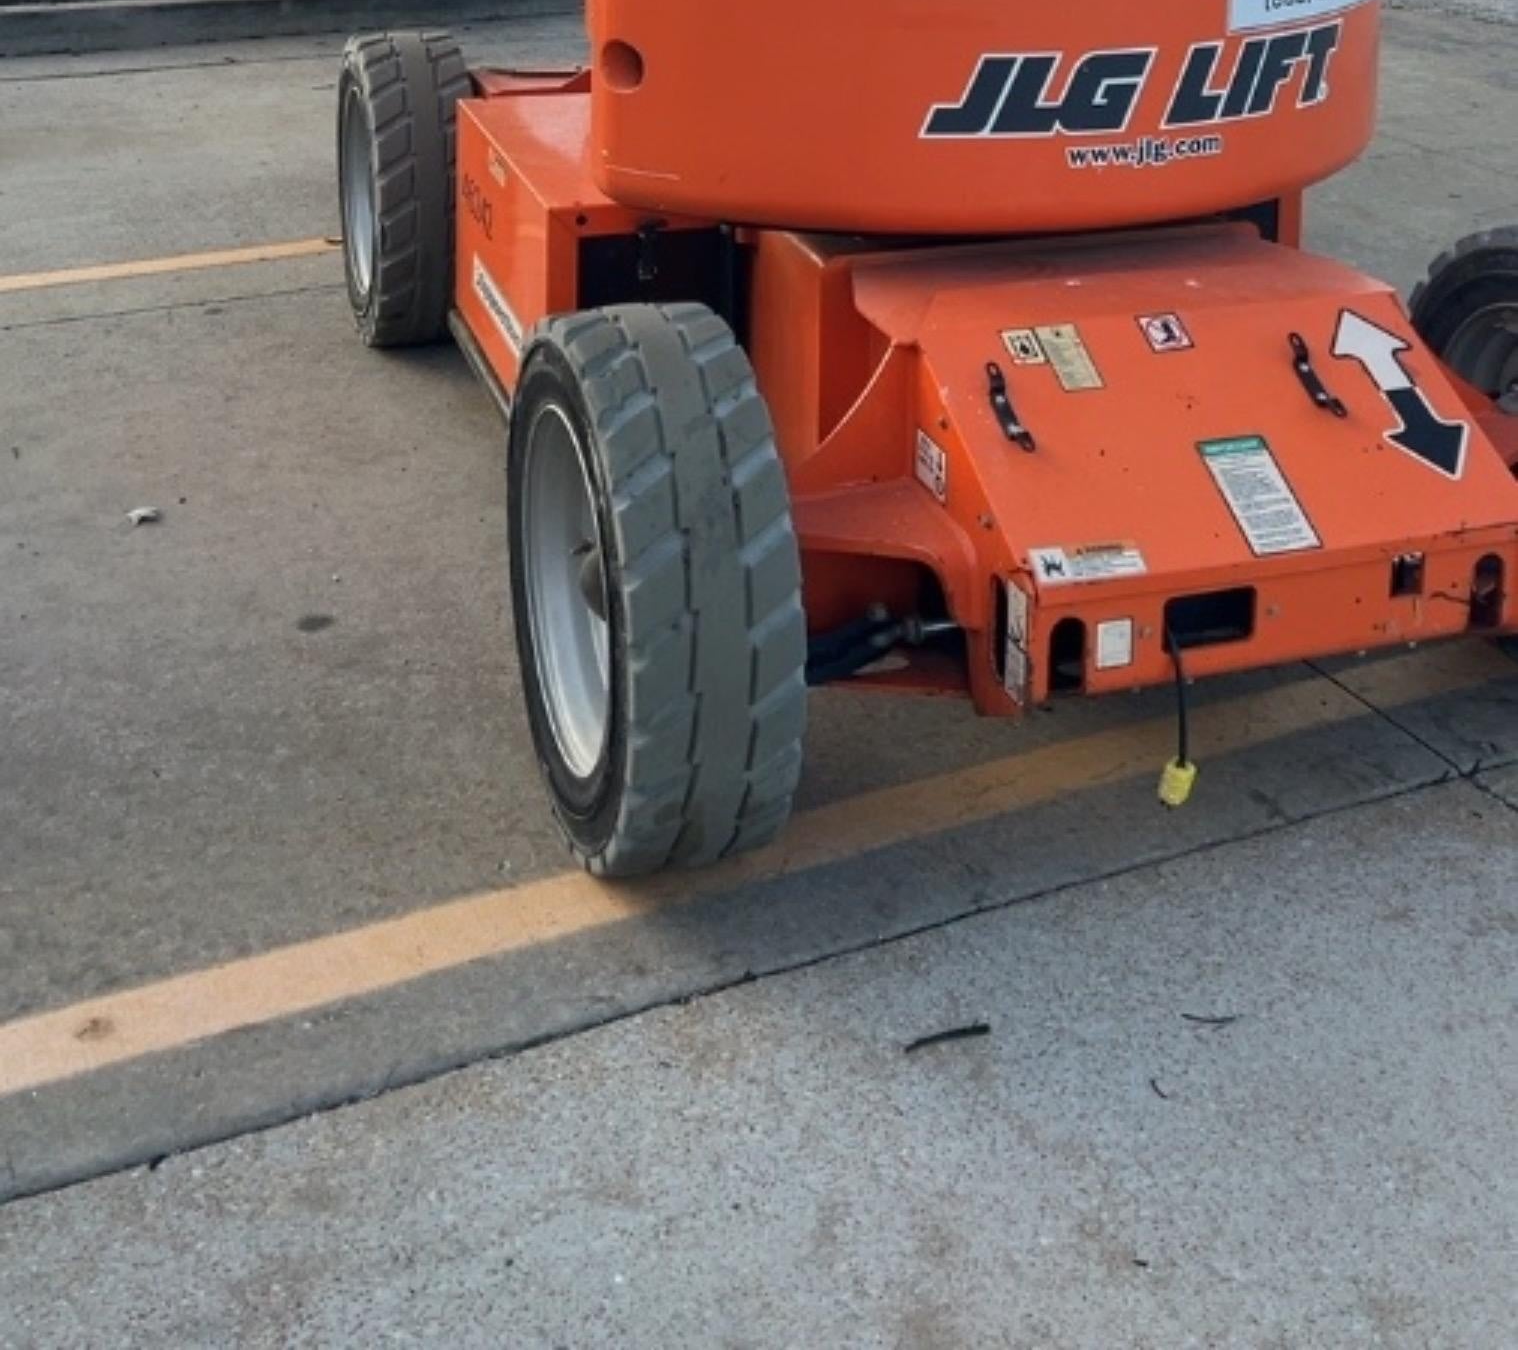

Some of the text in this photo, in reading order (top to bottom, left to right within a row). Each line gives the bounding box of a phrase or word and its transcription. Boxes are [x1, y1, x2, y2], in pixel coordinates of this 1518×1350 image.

[919, 19, 1343, 138] JLG LIFT
[1067, 133, 1222, 169] www.jlg.com
